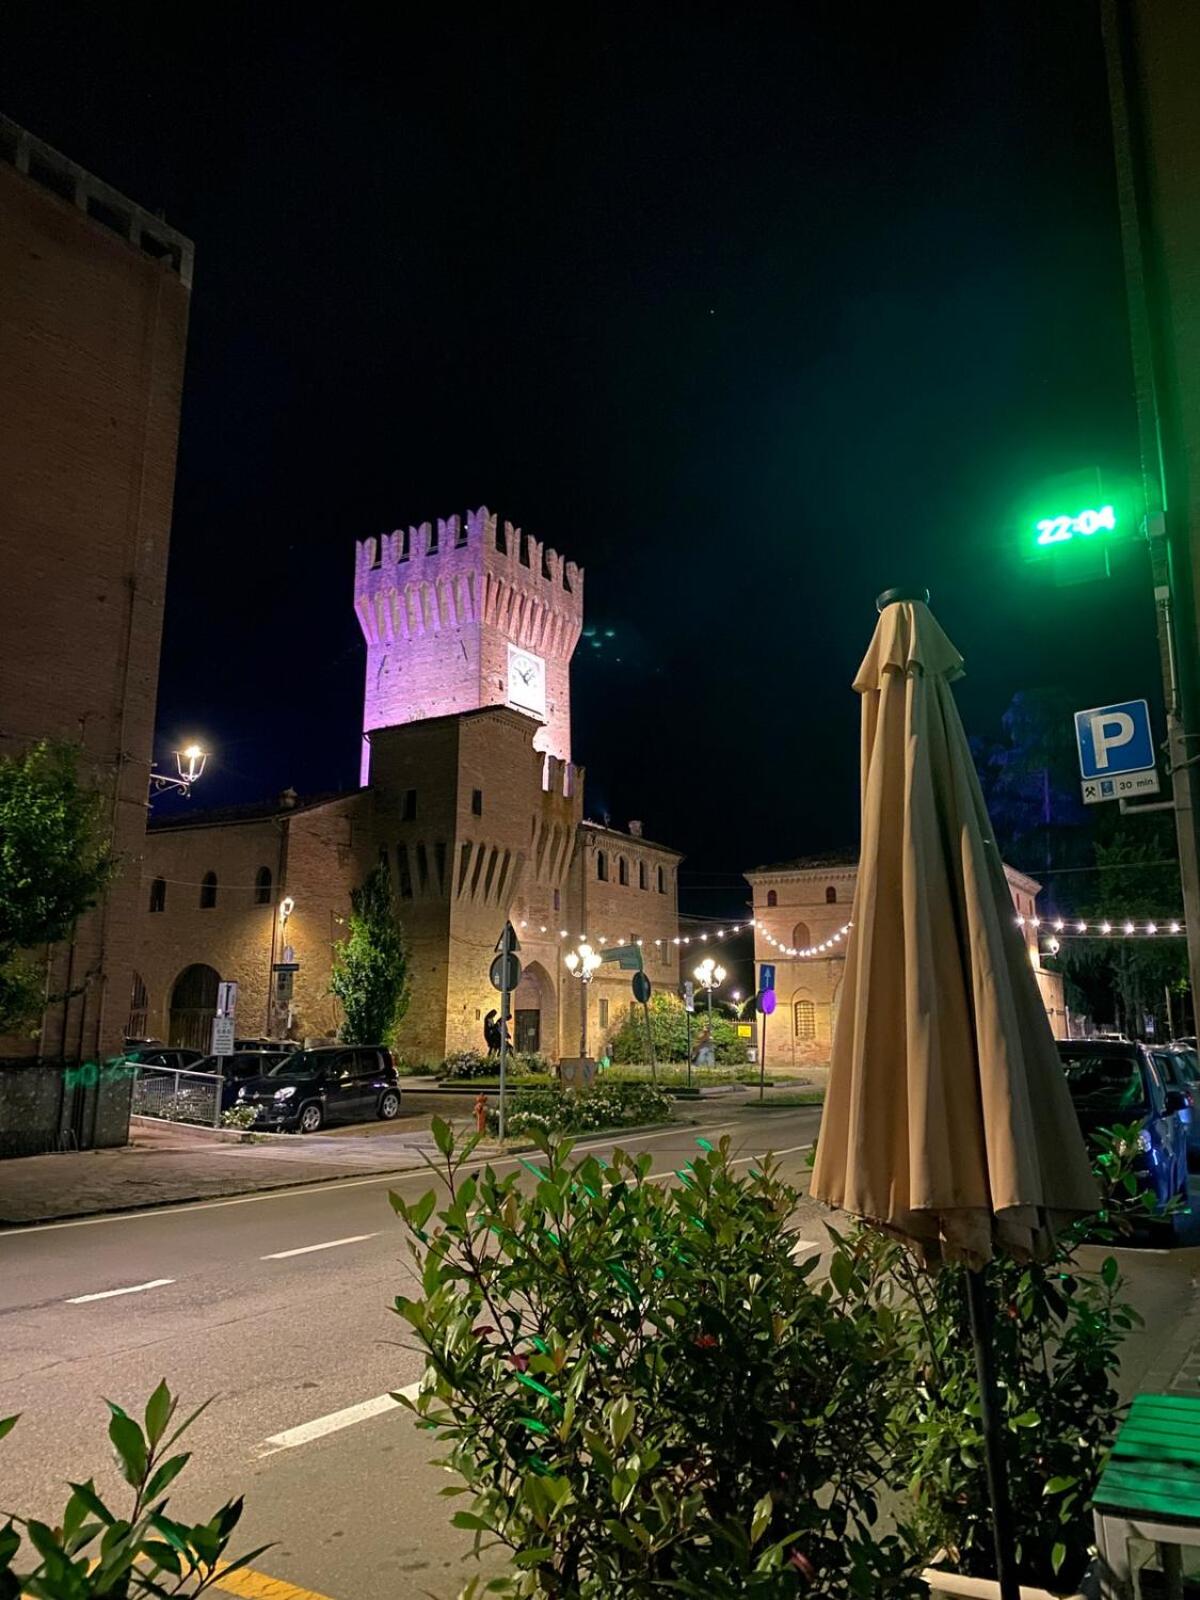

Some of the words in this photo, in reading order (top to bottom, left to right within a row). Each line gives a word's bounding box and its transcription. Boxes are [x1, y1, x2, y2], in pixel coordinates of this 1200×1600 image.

[1036, 505, 1115, 544] 22:04
[1090, 712, 1135, 769] P
[1119, 781, 1133, 790] 30
